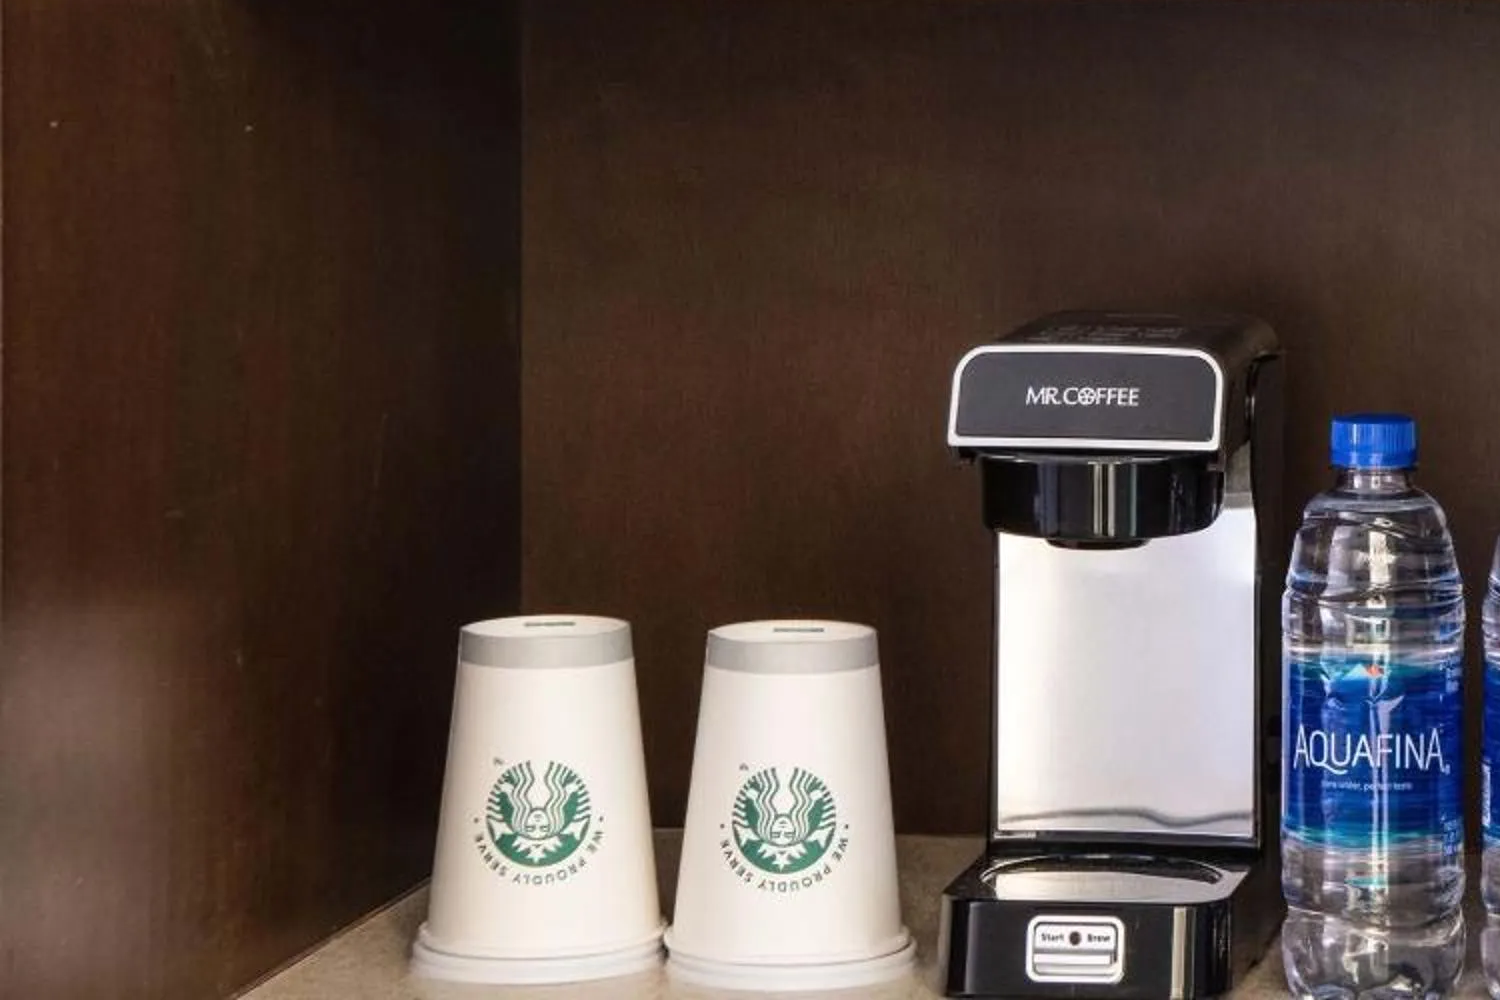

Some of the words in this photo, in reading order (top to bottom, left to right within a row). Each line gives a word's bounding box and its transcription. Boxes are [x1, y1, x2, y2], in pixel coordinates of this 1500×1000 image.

[1293, 723, 1445, 775] AQUAFINA
[474, 832, 509, 877] SERVE
[587, 829, 604, 854] WE
[832, 837, 849, 862] WE
[512, 856, 587, 886] PROUDLY
[720, 839, 754, 882] SERVE
[758, 864, 832, 893] PROUDLY
[1041, 933, 1065, 942] Start
[1087, 933, 1111, 942] Brew
